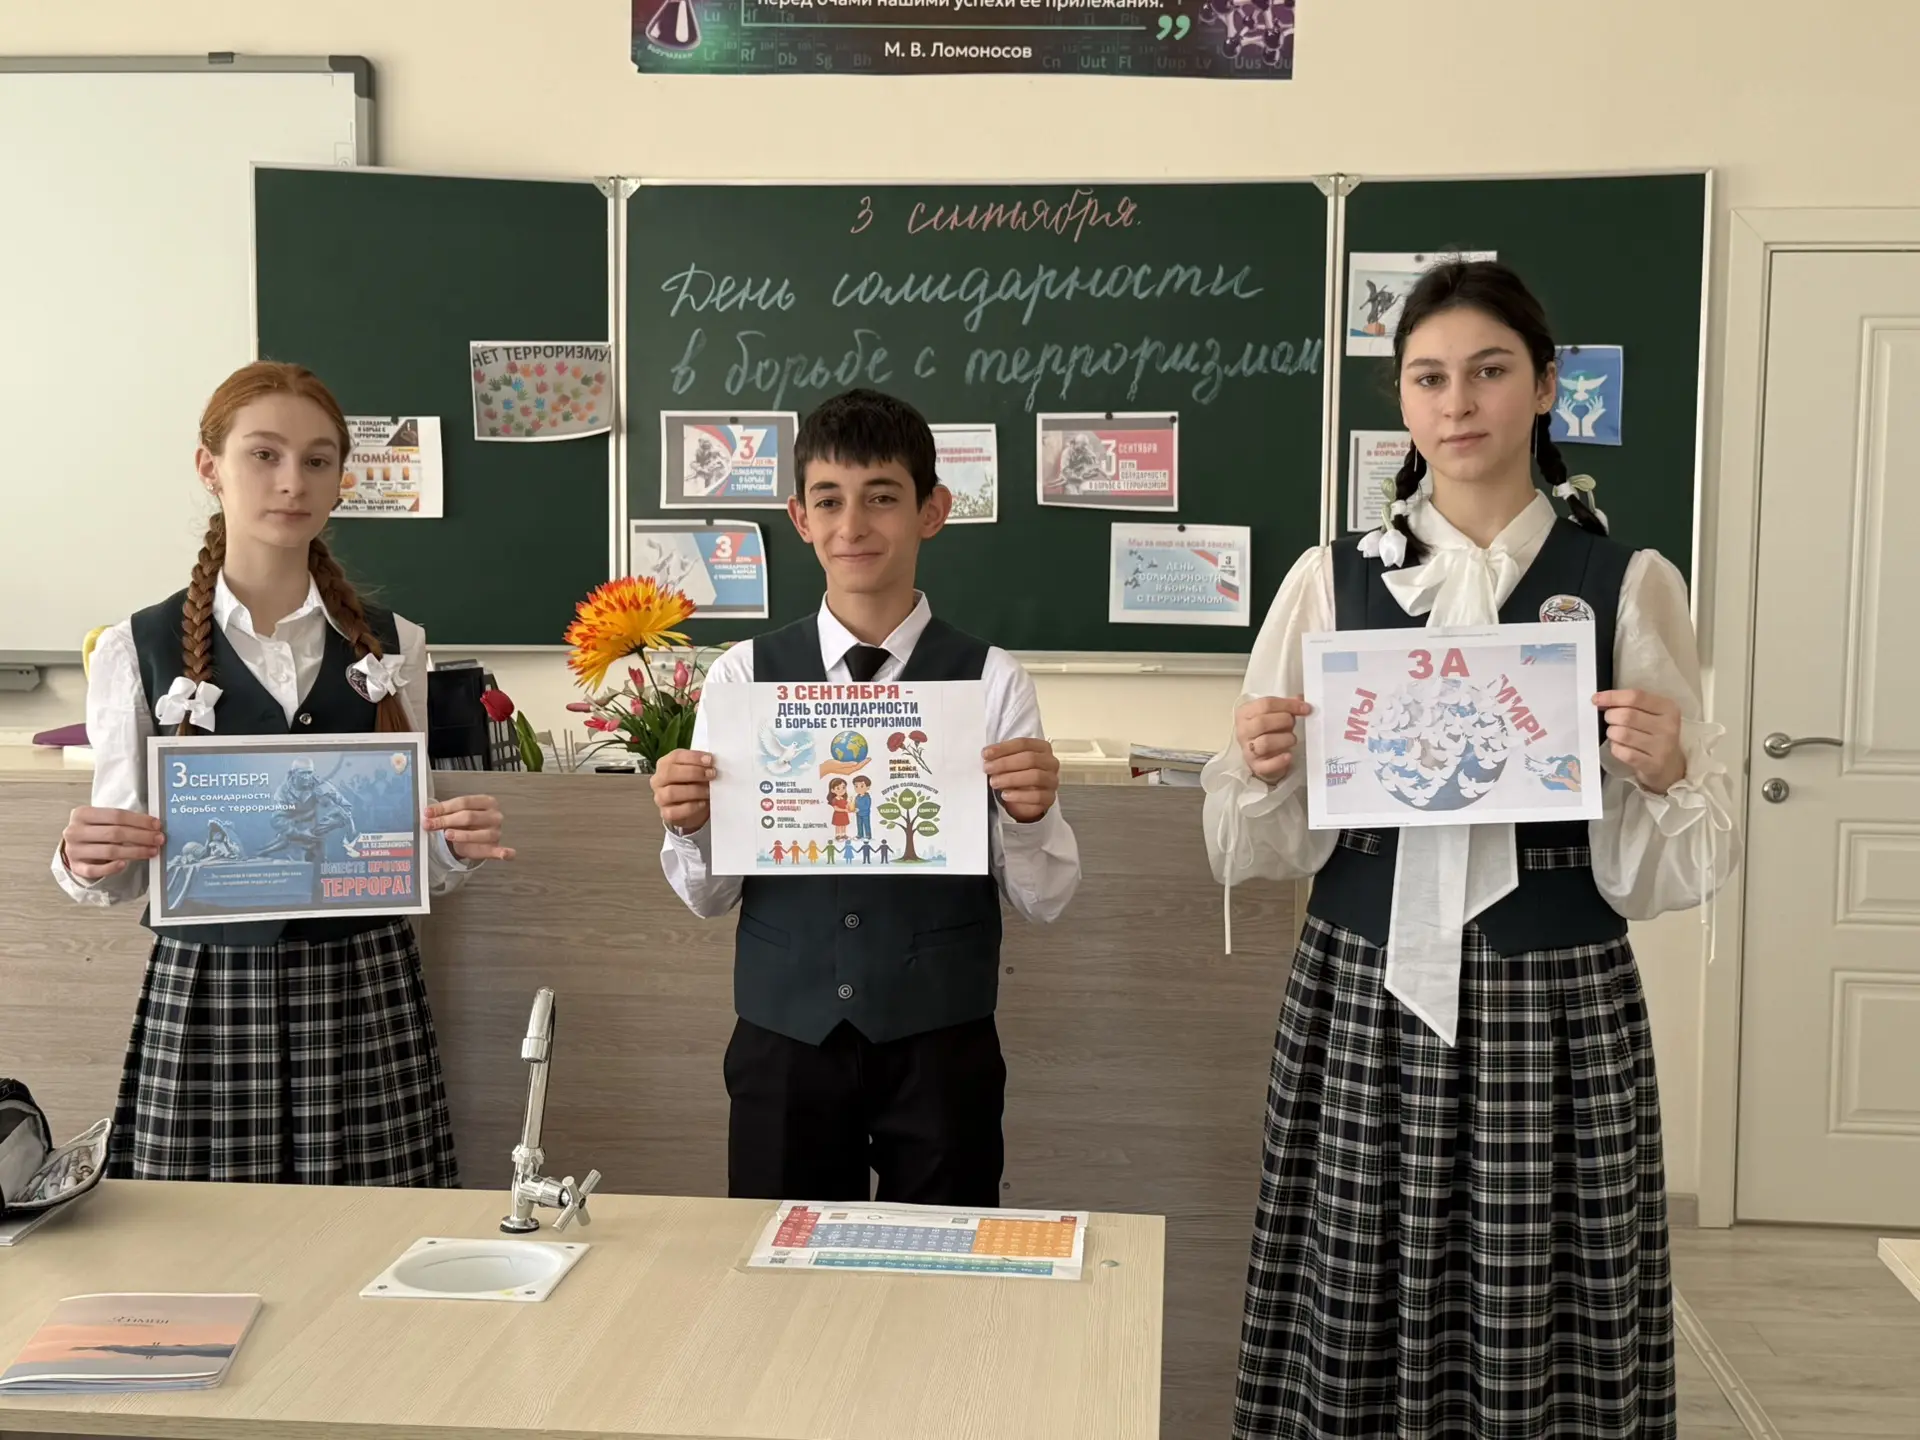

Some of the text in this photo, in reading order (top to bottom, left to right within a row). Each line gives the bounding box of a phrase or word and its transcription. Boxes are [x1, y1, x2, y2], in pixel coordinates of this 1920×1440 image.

[758, 0, 813, 9] перед
[953, 0, 1016, 10] успехи
[1045, 0, 1164, 11] прилежания.
[741, 47, 757, 61] Rf
[778, 52, 798, 66] Db
[884, 42, 1032, 60] М. В. Ломоносов
[850, 194, 874, 233] 3
[661, 260, 1265, 331] День солидарности
[472, 347, 499, 368] НЕТ
[671, 328, 1322, 412] в борьбе с терроризмом
[740, 436, 754, 460] 3
[1100, 439, 1158, 476] 3 СЕНТЯБРЯ
[715, 535, 732, 558] 3
[1166, 562, 1196, 572] ДЕНЬ
[1146, 596, 1224, 604] ТЕРРОРИЗМОМ
[776, 684, 788, 700] 3
[794, 684, 900, 700] СЕНТЯБРЯ
[1344, 687, 1378, 744] МЫ
[1407, 647, 1470, 680] ЗА
[778, 702, 918, 718] ДЕНЬ СОЛИДАРНОСТИ
[775, 717, 922, 729] В БОРЬБЕ С ТЕРРОРИЗМОМ
[172, 762, 270, 788] 3 СЕНТЯБРЯ
[170, 792, 270, 804] День солидарности
[180, 805, 217, 816] борьбе
[228, 804, 296, 814] терроризмом
[320, 861, 366, 874] ВМЕСТЕ
[320, 874, 411, 898] ТЕРРОРА!
